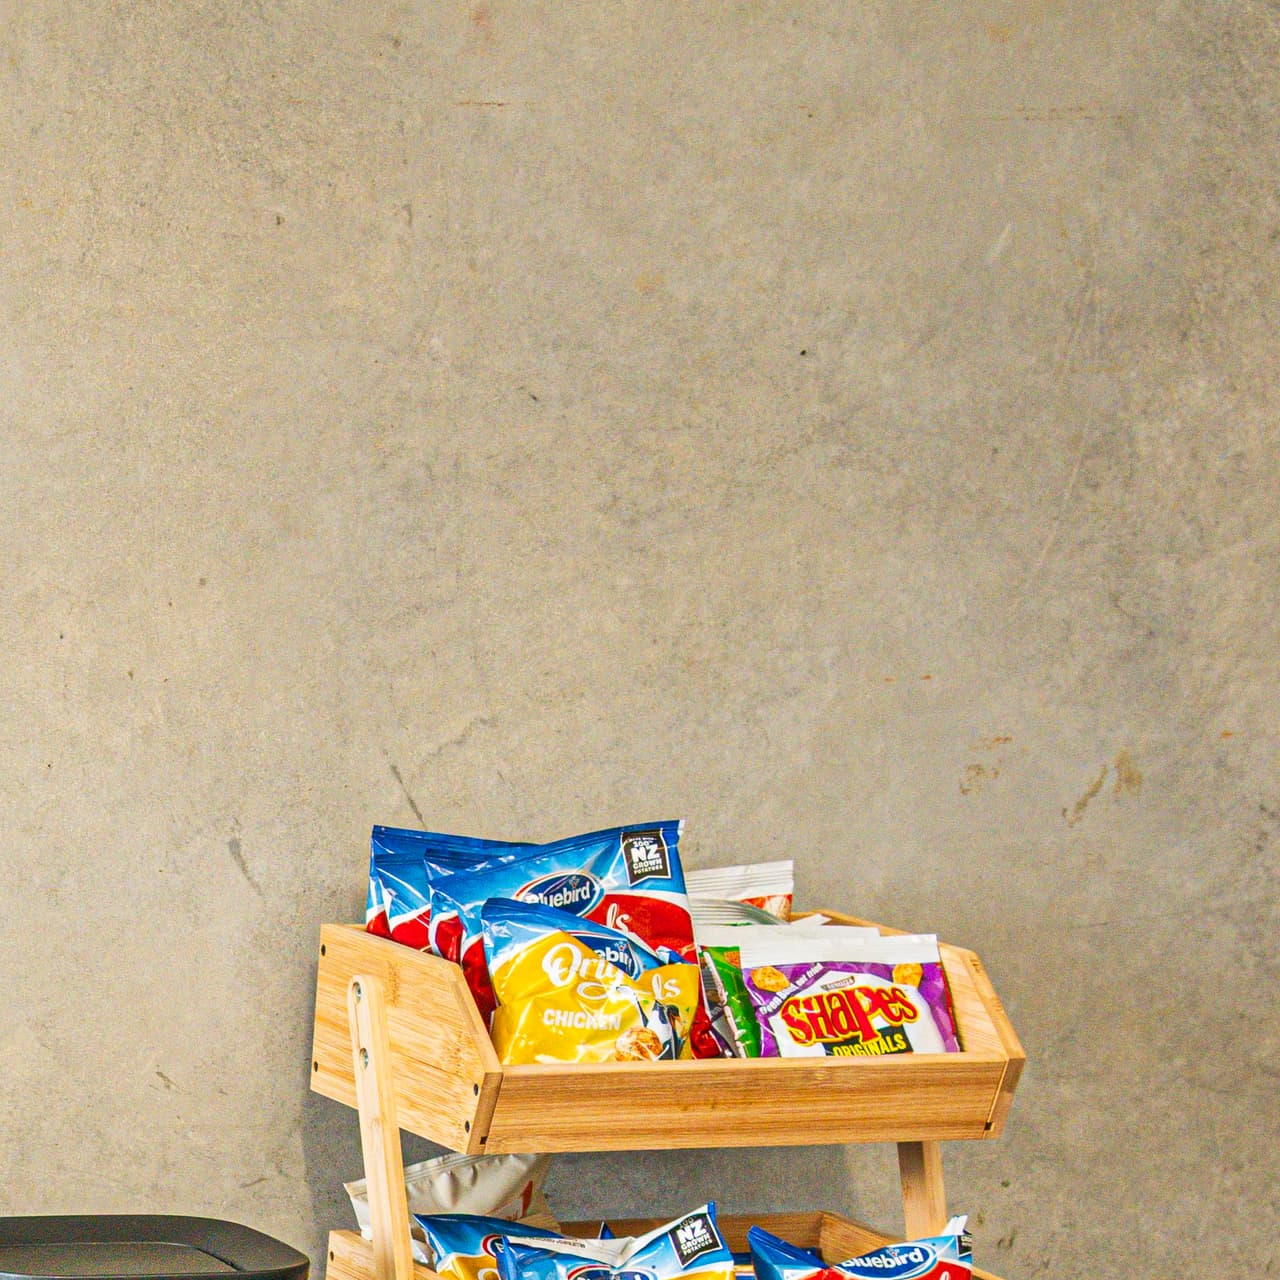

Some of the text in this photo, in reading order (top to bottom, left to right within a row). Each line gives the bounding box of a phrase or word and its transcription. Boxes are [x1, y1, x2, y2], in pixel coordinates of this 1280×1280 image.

[630, 843, 660, 863] NZ
[632, 858, 662, 869] GROWN
[543, 1008, 623, 1031] CHICKEN
[832, 1033, 907, 1057] ORIGINALS
[676, 1218, 708, 1244] NZ
